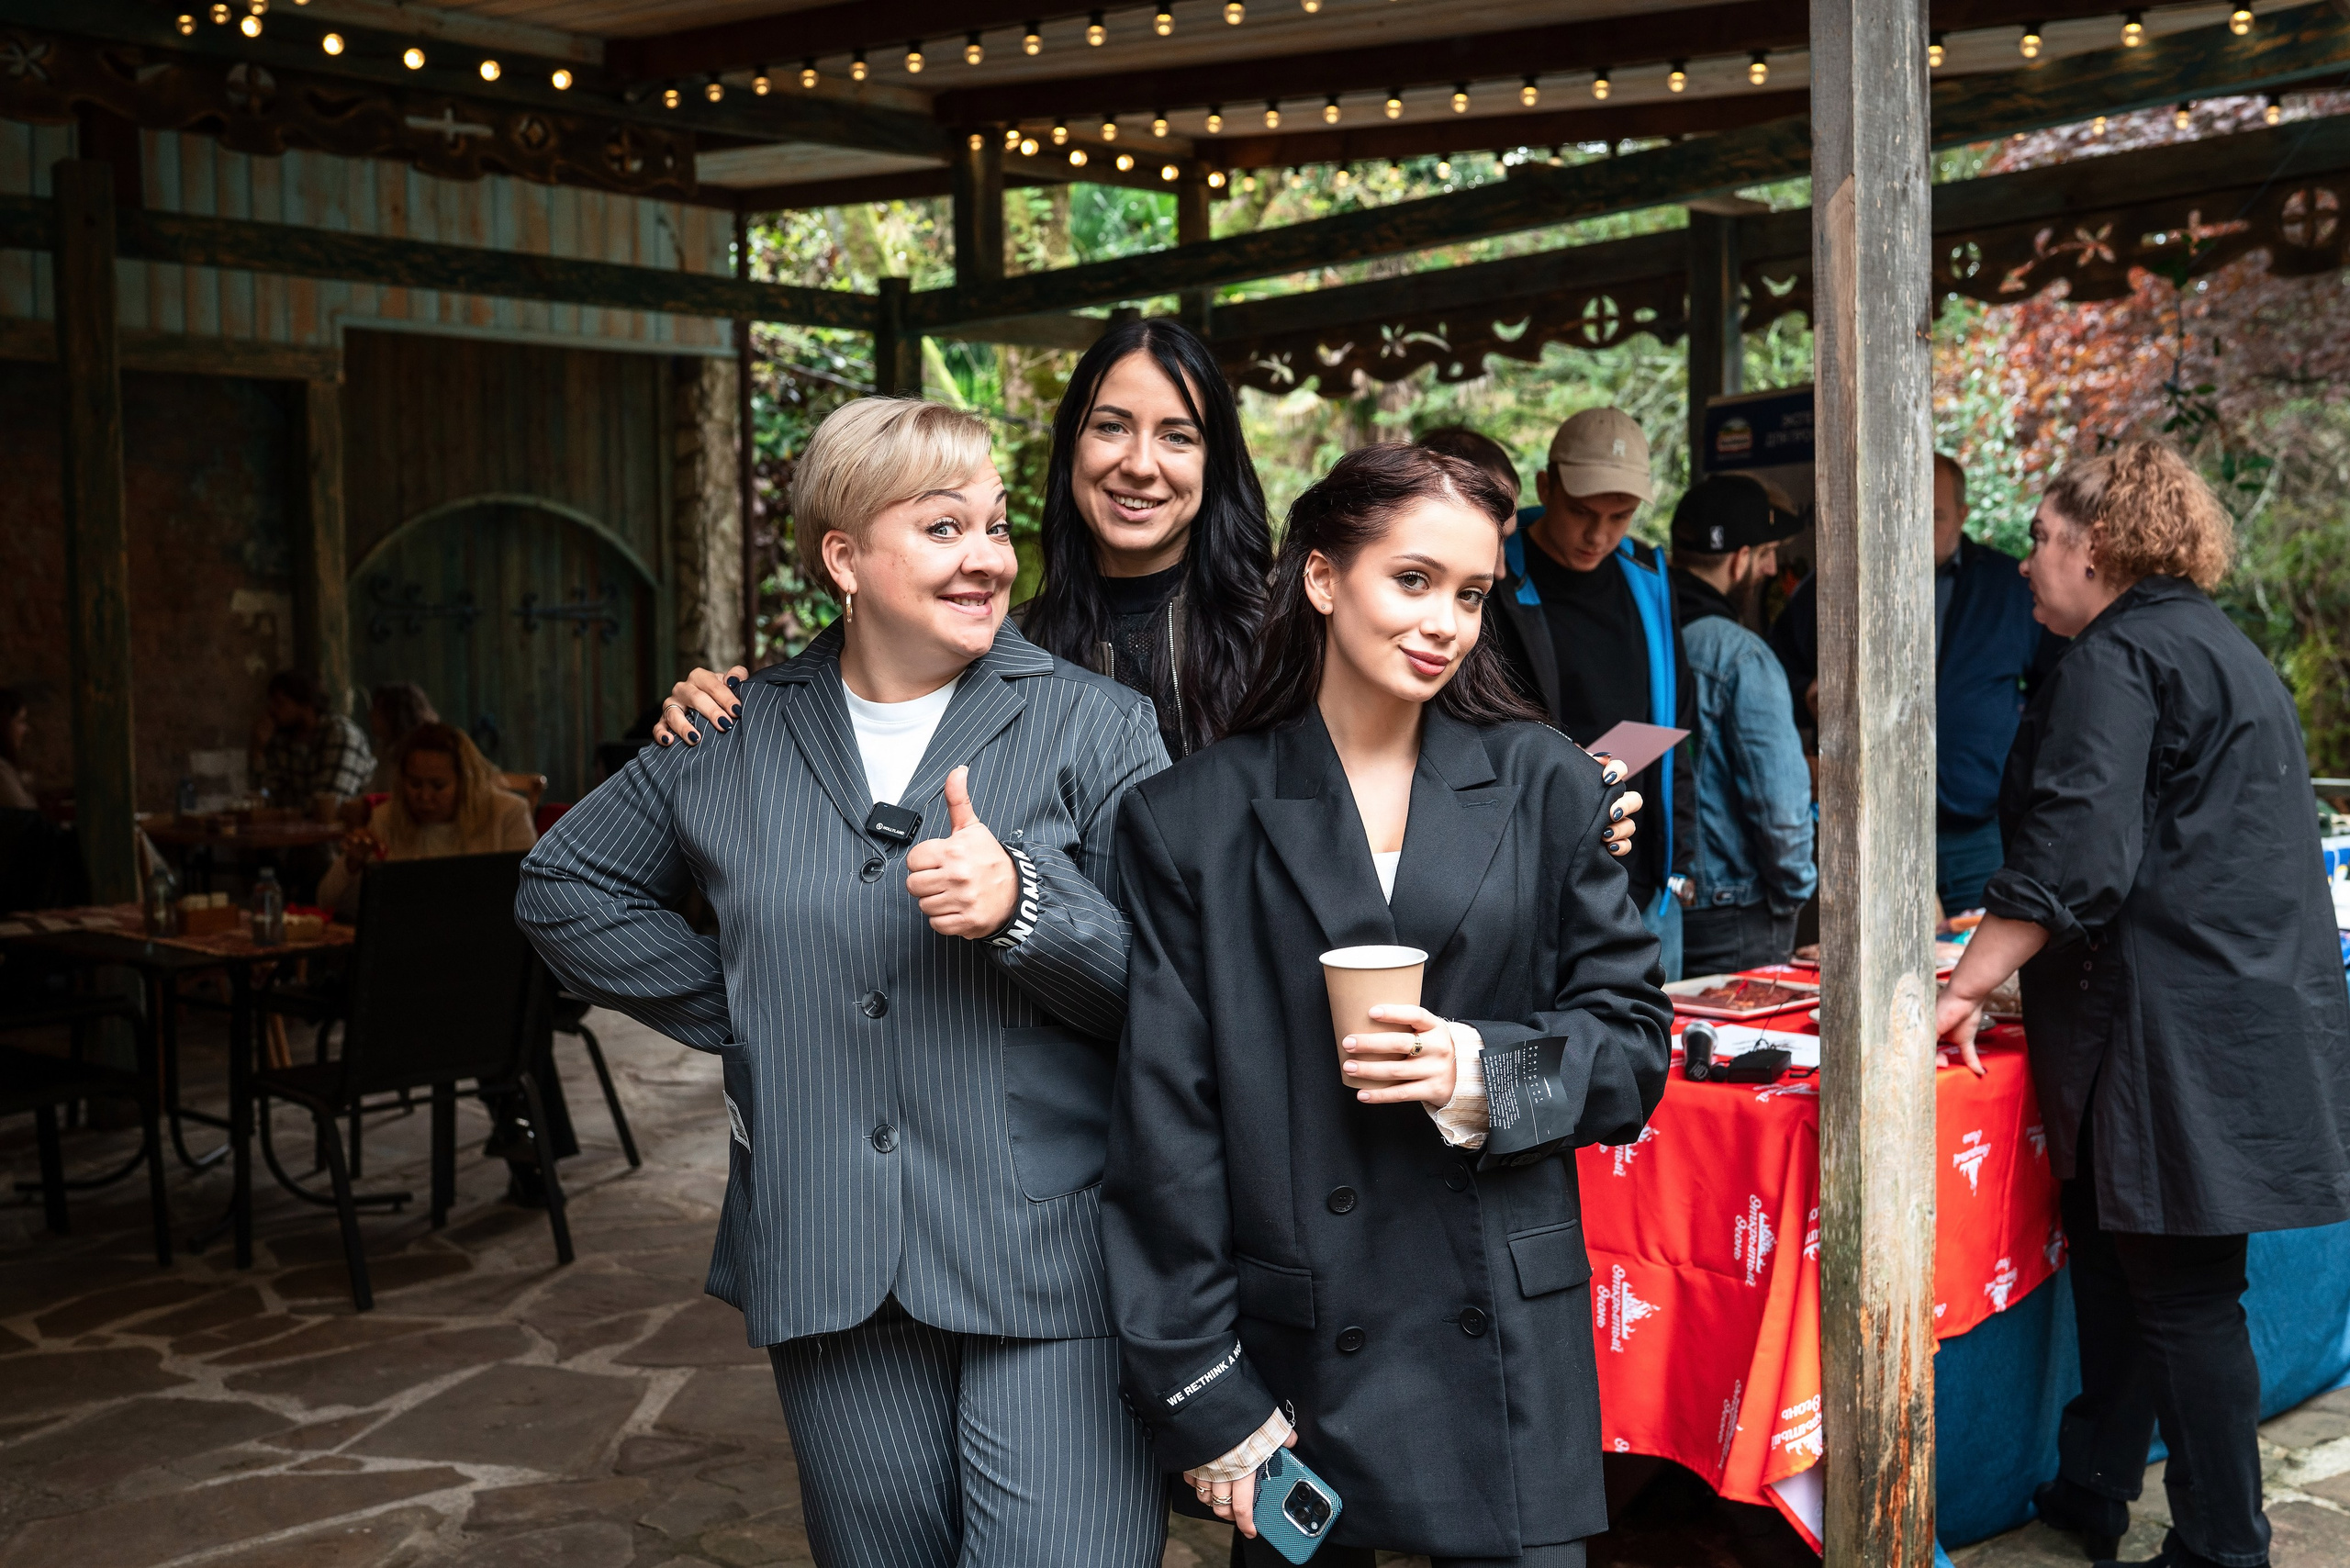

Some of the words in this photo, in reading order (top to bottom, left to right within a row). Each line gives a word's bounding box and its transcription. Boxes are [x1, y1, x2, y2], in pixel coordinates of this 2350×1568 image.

[1734, 1215, 1747, 1260] Огонь
[1745, 1194, 1762, 1287] Открытый
[1596, 1284, 1611, 1328] Огонь
[1610, 1264, 1626, 1353] Открытый
[1166, 1391, 1185, 1406] WE
[1184, 1360, 1229, 1396] RE:THINK
[1228, 1355, 1236, 1365] A
